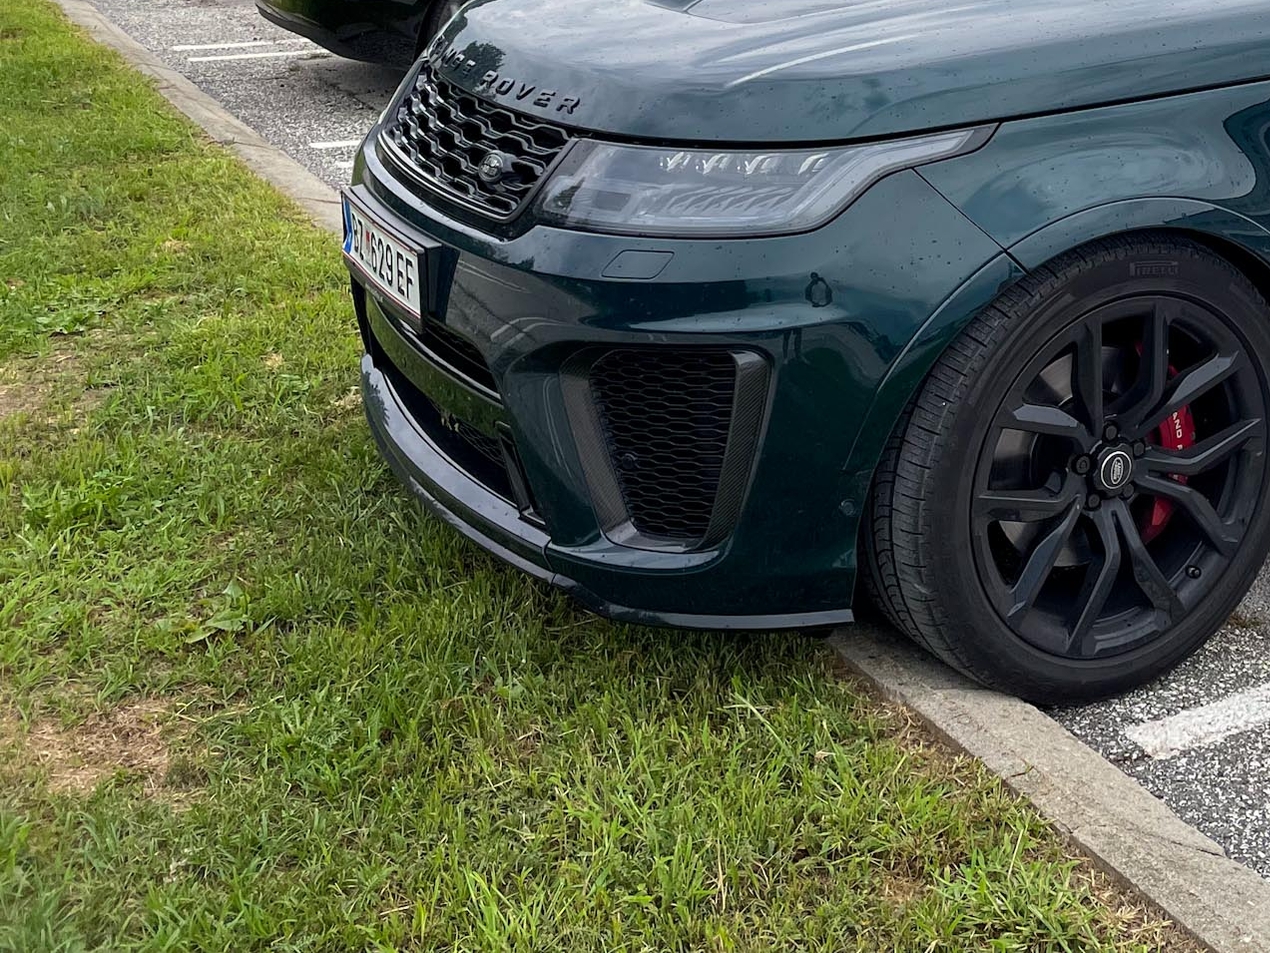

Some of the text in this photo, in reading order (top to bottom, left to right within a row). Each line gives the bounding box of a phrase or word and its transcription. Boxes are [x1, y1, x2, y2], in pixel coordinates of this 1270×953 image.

[480, 70, 580, 114] ROVER
[351, 212, 415, 301] BZ 629 EF
[1172, 411, 1183, 439] AND
